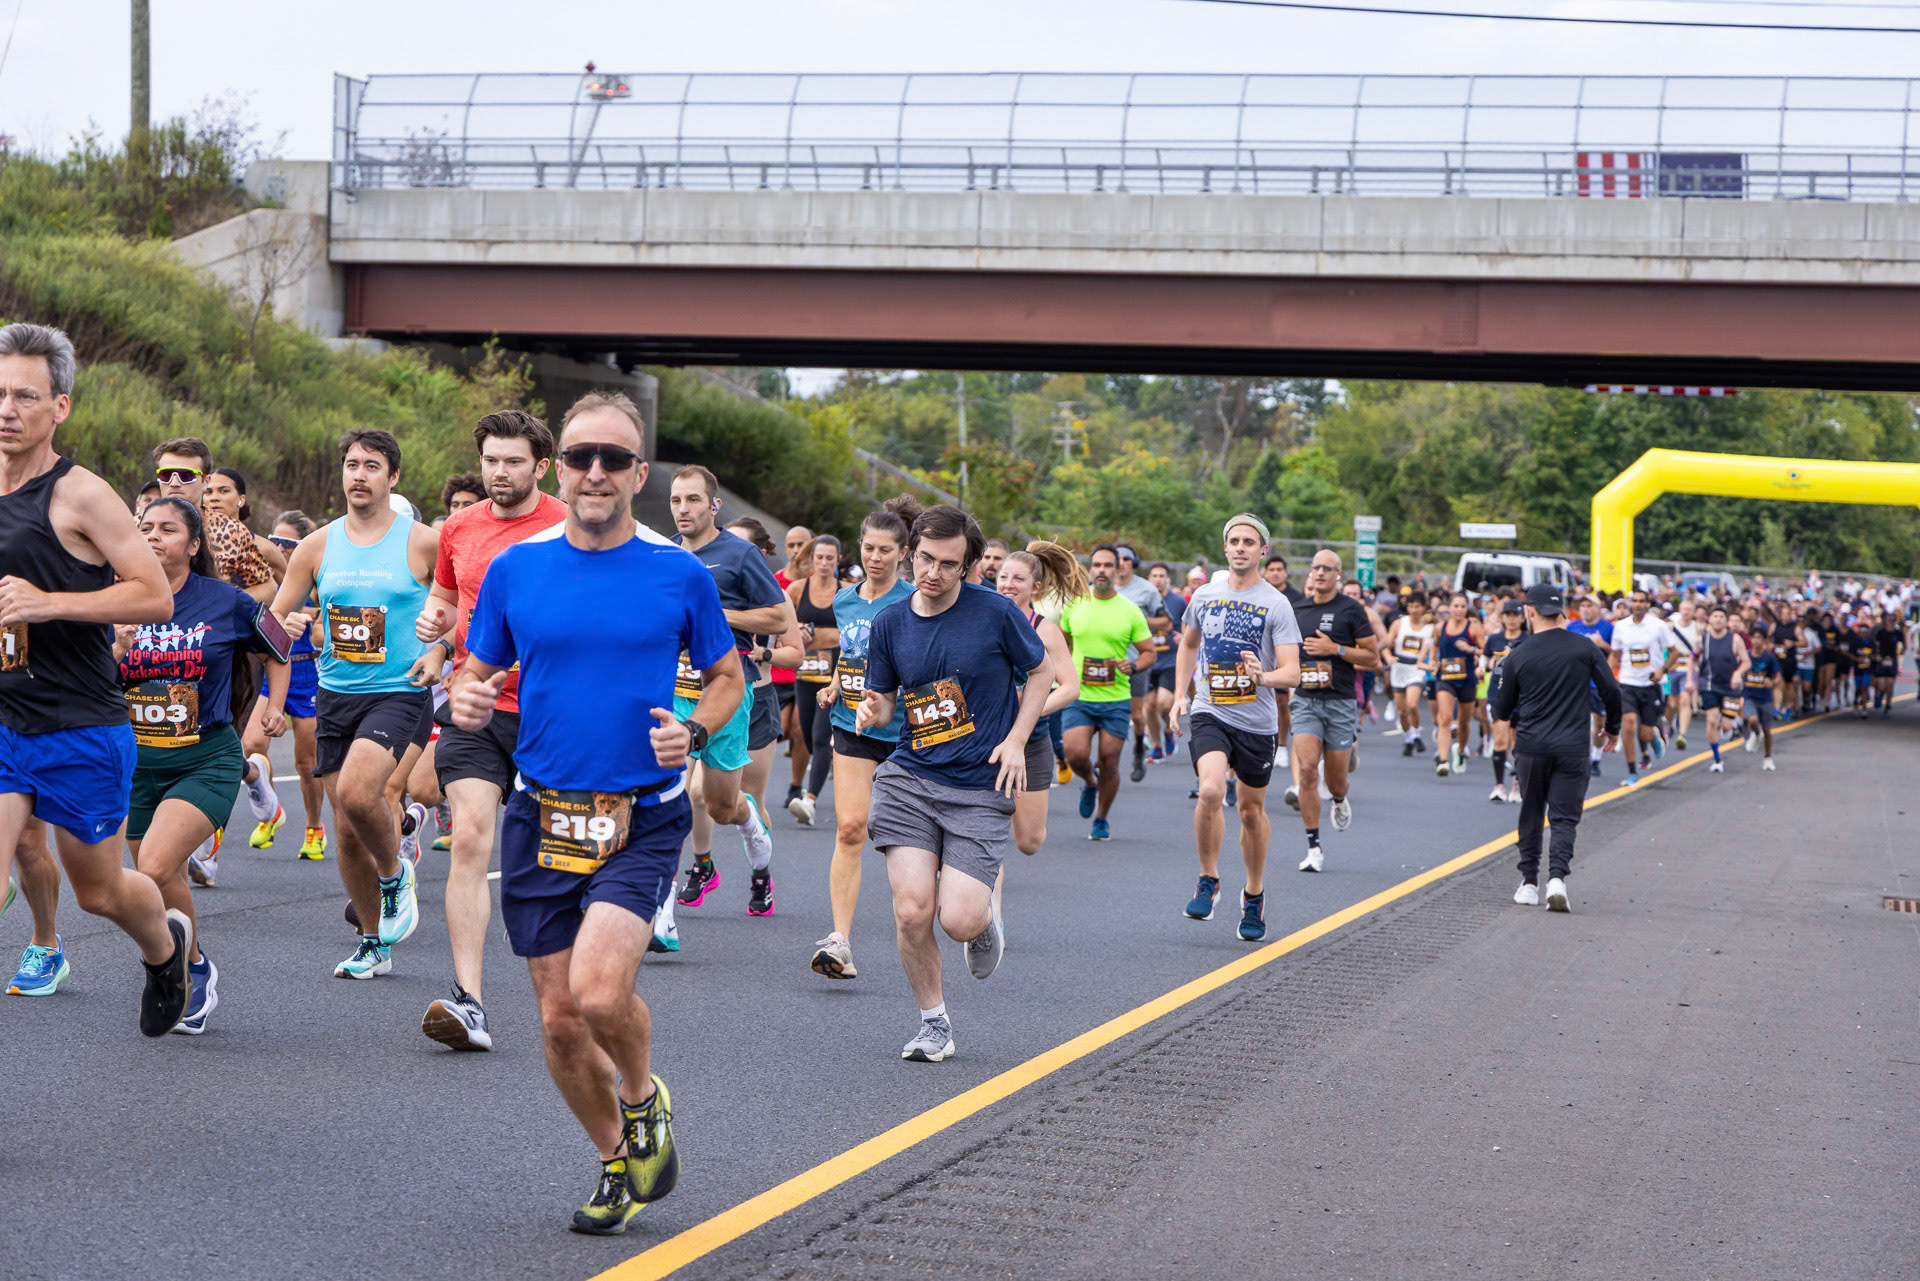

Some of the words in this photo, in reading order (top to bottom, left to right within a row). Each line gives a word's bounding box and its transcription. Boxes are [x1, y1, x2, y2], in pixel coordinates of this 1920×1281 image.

[359, 569, 393, 580] Running
[336, 579, 373, 588] Company
[338, 623, 370, 641] 30
[151, 645, 203, 667] Running
[120, 660, 181, 681] Packanack
[183, 660, 207, 681] Day
[840, 674, 865, 690] 28
[1211, 675, 1251, 688] 275
[124, 694, 153, 702] CHASE
[905, 697, 926, 708] CHASE
[131, 703, 188, 723] 103
[913, 699, 957, 725] 143
[541, 798, 572, 811] CHASE
[573, 803, 591, 812] 5K
[550, 812, 616, 841] 219
